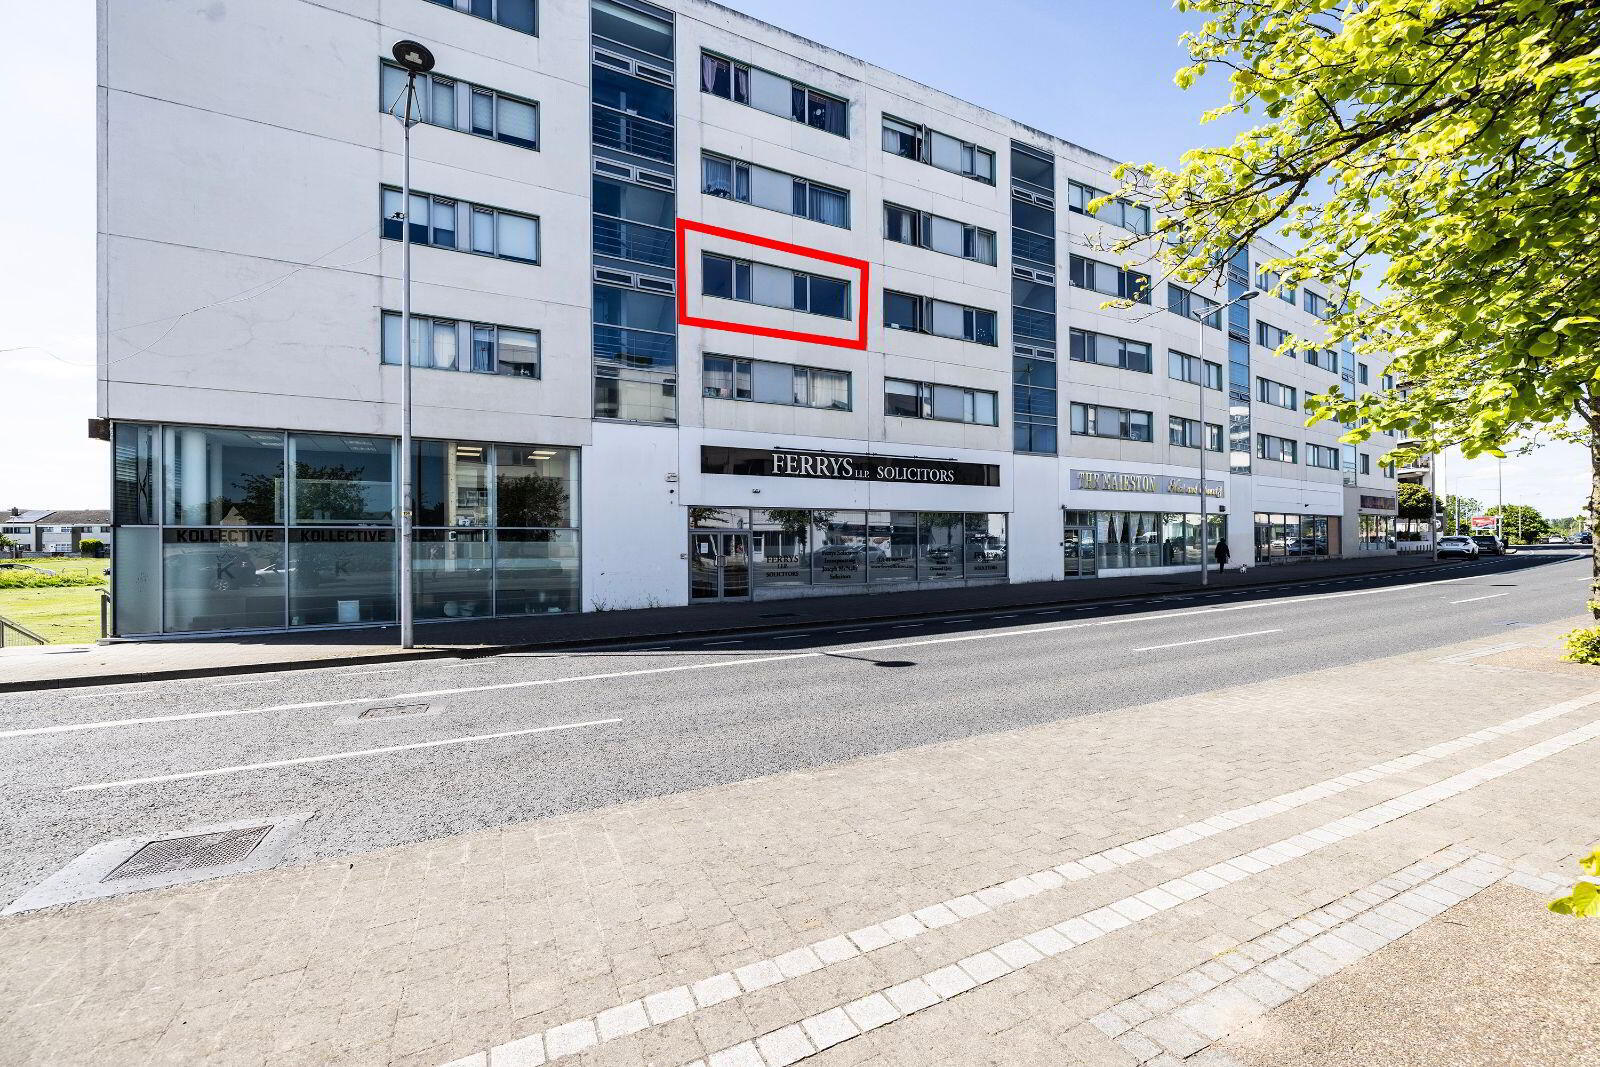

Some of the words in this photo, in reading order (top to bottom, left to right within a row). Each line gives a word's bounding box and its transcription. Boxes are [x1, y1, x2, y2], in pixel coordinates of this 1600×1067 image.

[771, 453, 853, 477] FERRYS
[876, 465, 955, 482] SOLICITORS
[176, 529, 274, 543] KOLLECTIVE
[300, 529, 386, 542] KOLLECTIVE
[766, 555, 799, 563] FERRYS
